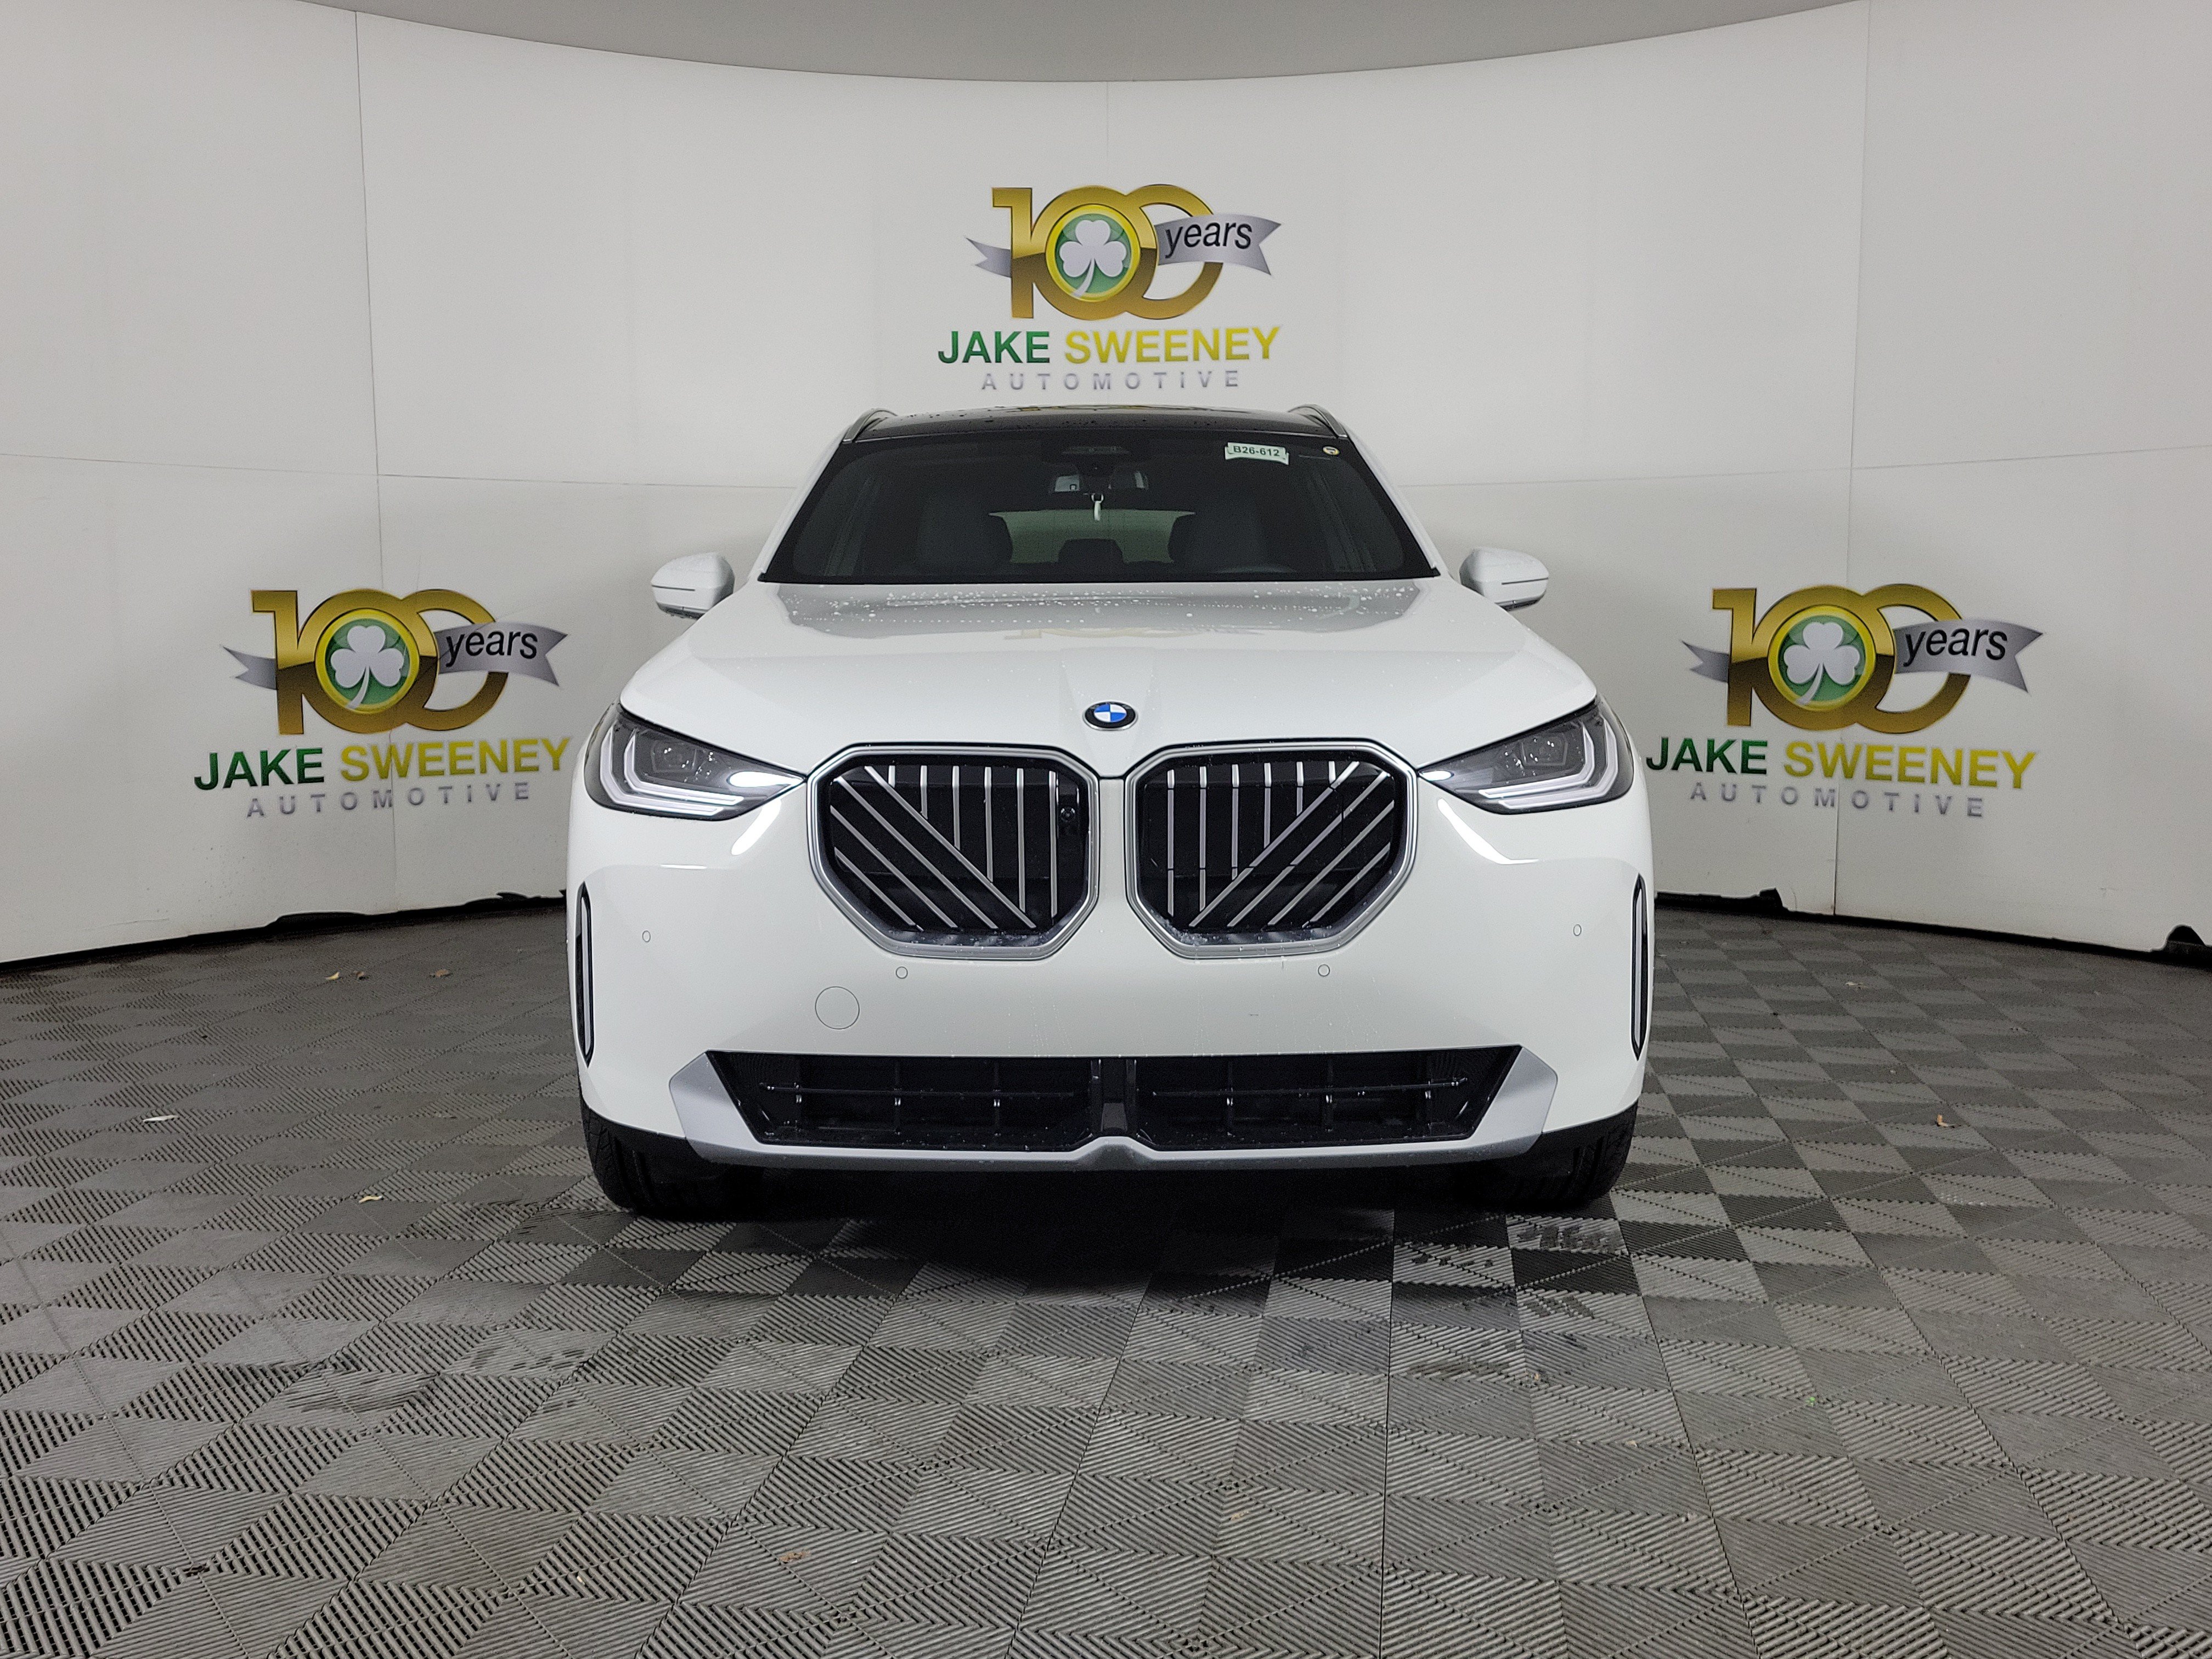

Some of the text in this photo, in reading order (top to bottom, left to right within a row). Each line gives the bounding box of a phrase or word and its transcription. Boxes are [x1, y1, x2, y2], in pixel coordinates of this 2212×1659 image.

[991, 183, 1252, 320] 100 years
[938, 326, 1280, 363] JAKE SWEENEY
[981, 370, 1239, 390] AUTOMOTIVE
[1233, 445, 1280, 456] B26-612
[250, 588, 538, 735] 100 years
[1711, 583, 2008, 734] 100 years
[194, 737, 572, 791] JAKE SWEENEY
[1646, 737, 2036, 789] JAKE SWEENEY
[247, 782, 529, 818] AUTOMOTIVE
[1690, 782, 1983, 817] AUTOMOTIVE
